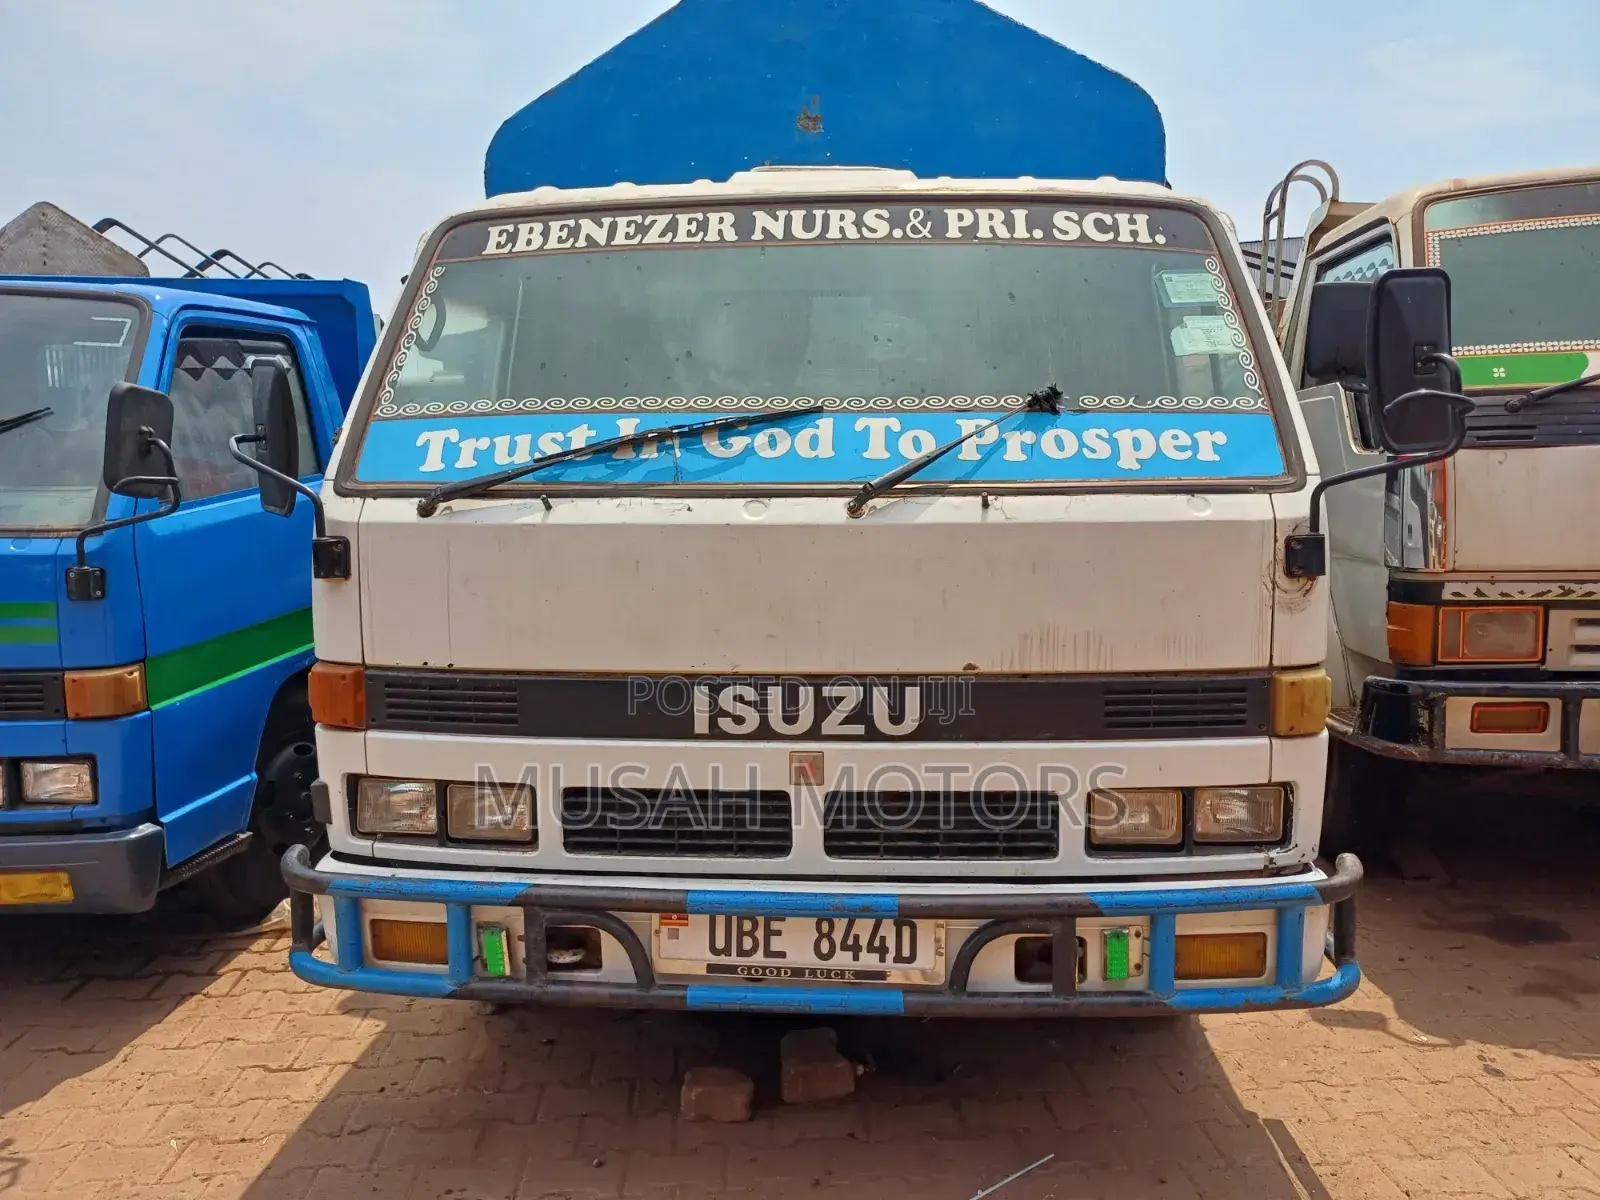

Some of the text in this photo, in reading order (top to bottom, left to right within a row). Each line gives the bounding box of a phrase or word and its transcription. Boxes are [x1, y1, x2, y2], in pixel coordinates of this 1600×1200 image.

[481, 211, 738, 255] EBENEZER
[943, 208, 1044, 239] PRI.
[1052, 210, 1167, 245] SCH.
[416, 423, 597, 472] Trust
[702, 416, 836, 460] God
[854, 416, 936, 460] To
[956, 418, 1228, 471] Prosper
[693, 684, 921, 736] ISUZU
[708, 914, 918, 965] UBE 844D
[736, 965, 857, 980] GOOD LUCK
